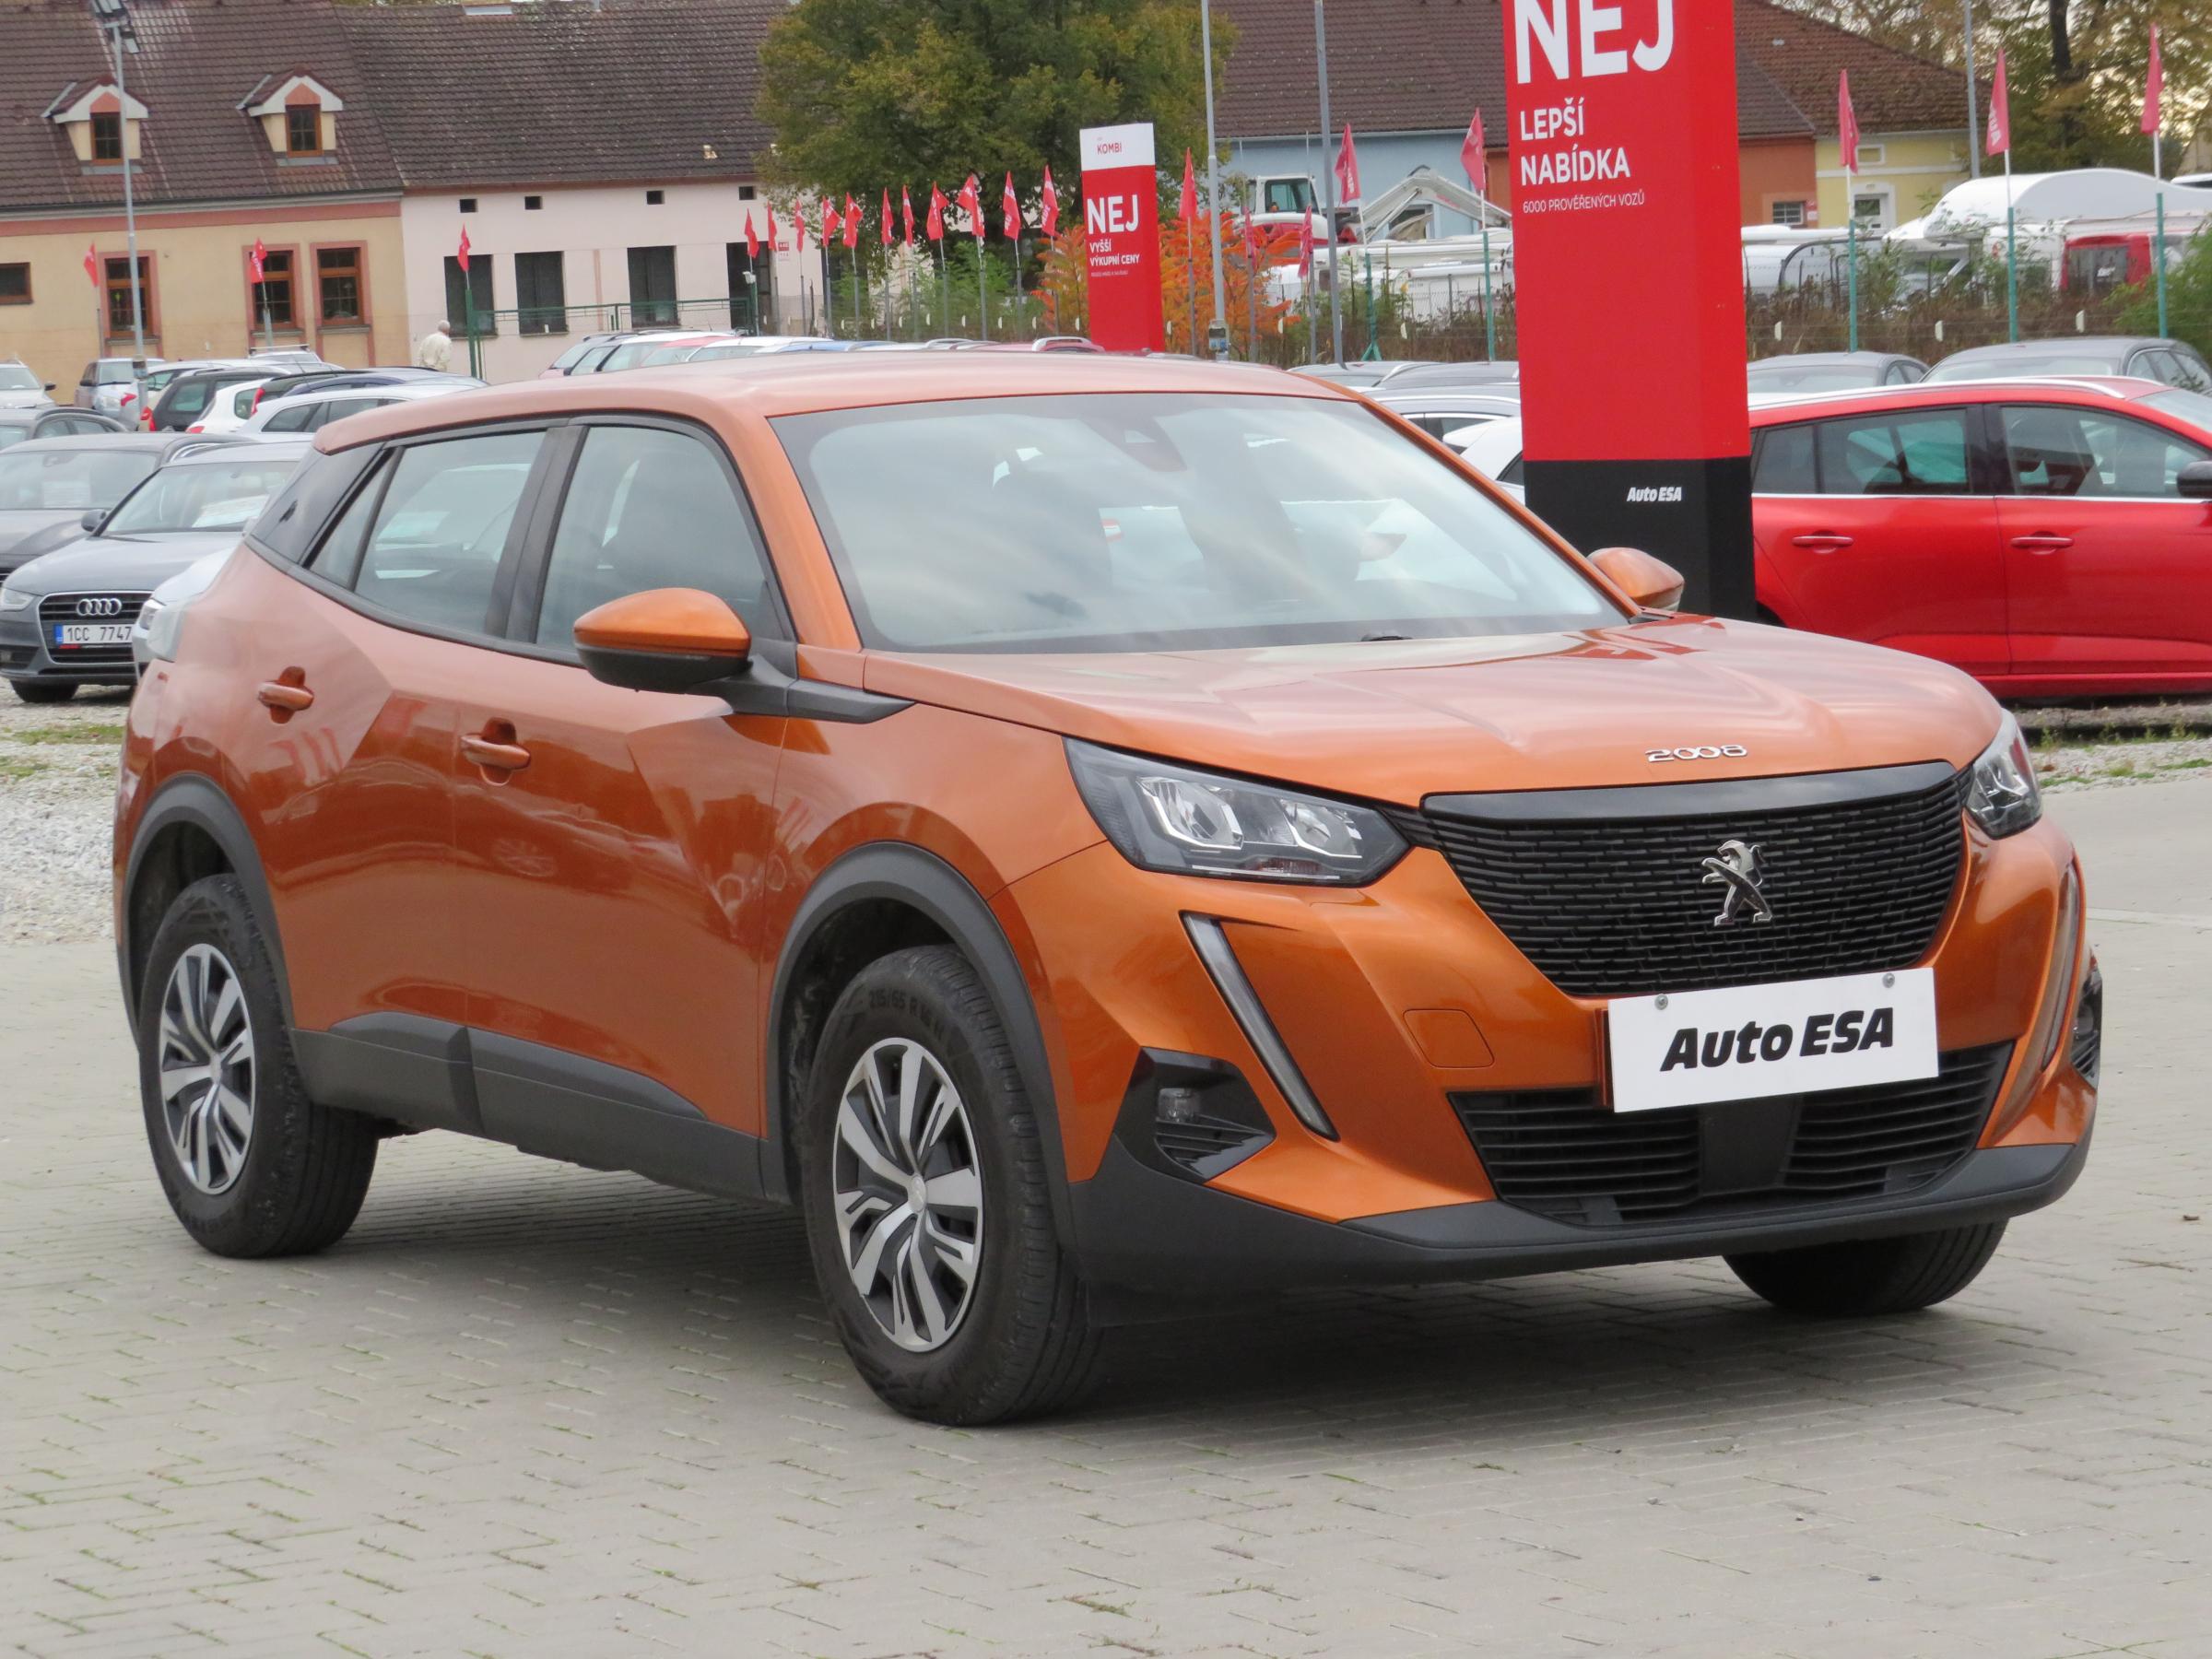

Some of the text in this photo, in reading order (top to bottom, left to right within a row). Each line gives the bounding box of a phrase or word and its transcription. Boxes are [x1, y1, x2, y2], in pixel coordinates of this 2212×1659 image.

[1514, 0, 1674, 84] NEJ
[1520, 97, 1585, 141] LEPŠÍ
[1521, 144, 1631, 186] NABÍDKA
[1087, 194, 1139, 235] NEJ
[1523, 189, 1645, 213] 6000 PROVĚŘENÝCH VOZŮ
[1121, 253, 1140, 265] CENY
[1626, 487, 1682, 502] Auto ESA
[67, 626, 132, 641] 1CC 7747
[1644, 745, 1748, 763] 2008
[1659, 1006, 1894, 1072] Auto ESA
